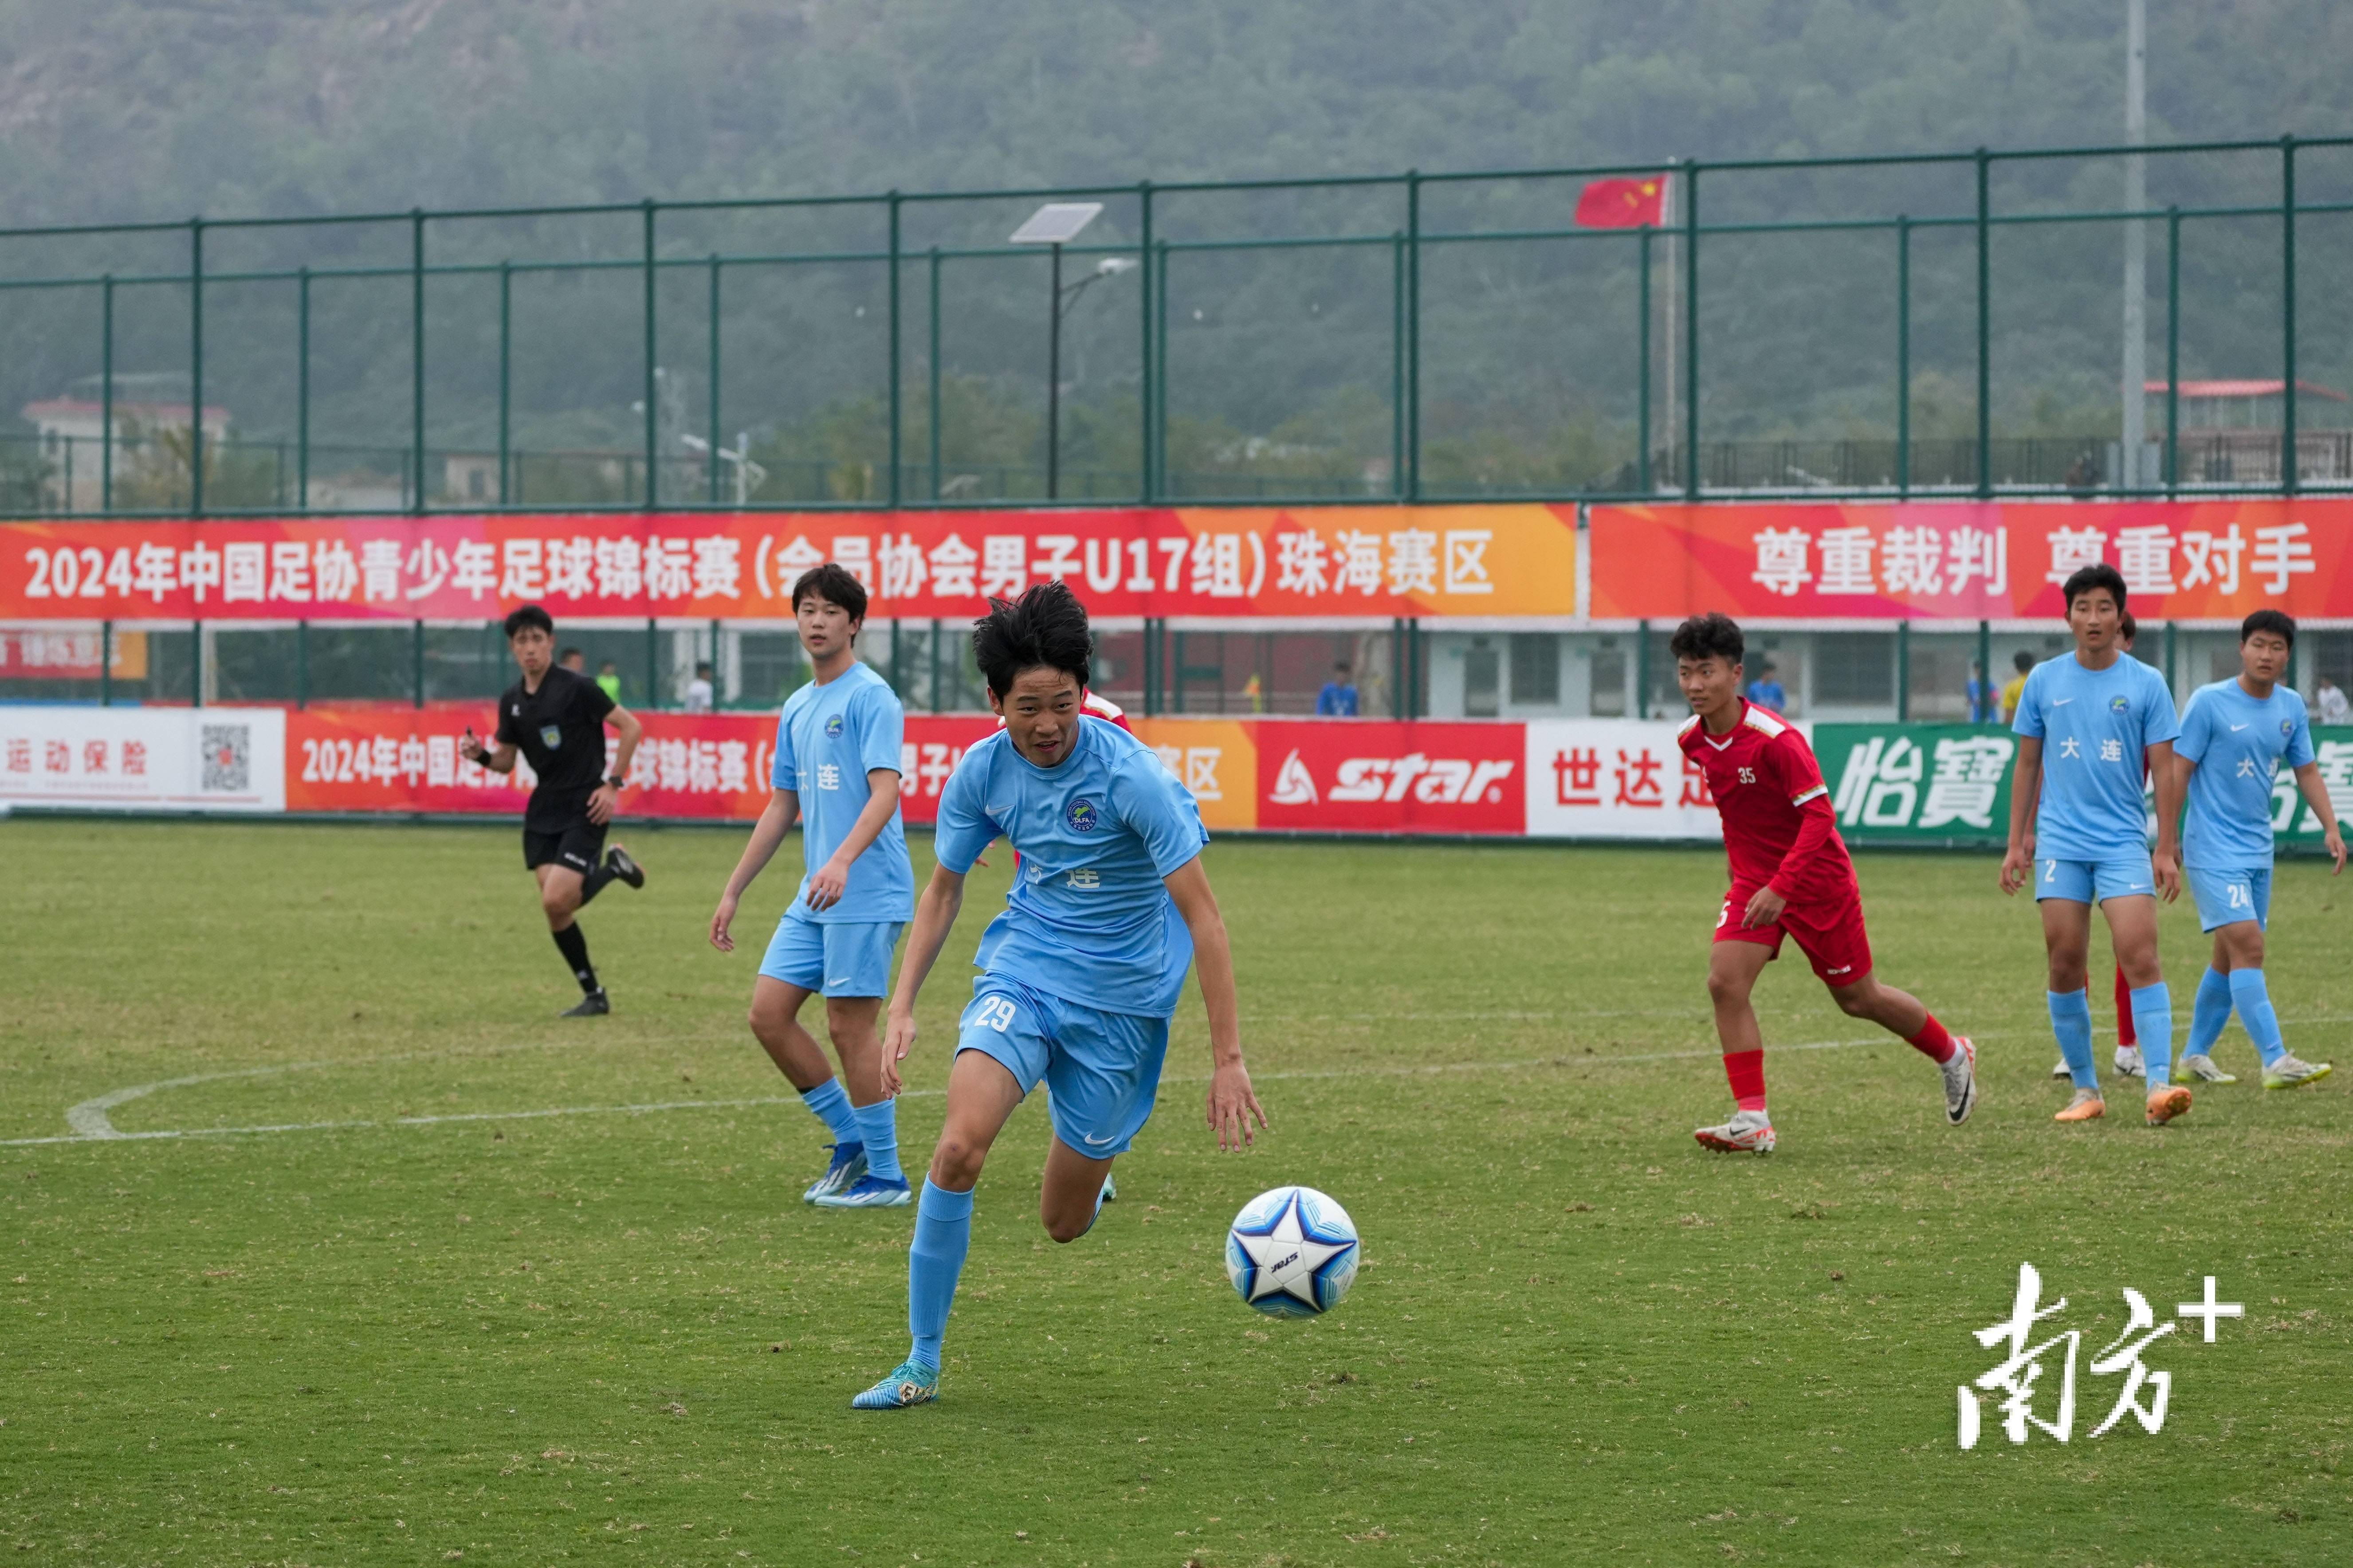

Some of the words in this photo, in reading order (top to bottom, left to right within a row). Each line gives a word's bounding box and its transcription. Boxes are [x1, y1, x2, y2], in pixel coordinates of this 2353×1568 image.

[1752, 524, 2007, 597] 尊重裁判
[2045, 522, 2316, 595] 尊重对手
[7, 739, 147, 774] 运动保险
[2060, 736, 2122, 762] 大连
[1328, 752, 1515, 804] star
[1738, 767, 1756, 784] 35
[1834, 735, 2015, 828] 怡寶
[2045, 860, 2056, 882] 2
[974, 996, 1016, 1032] 29
